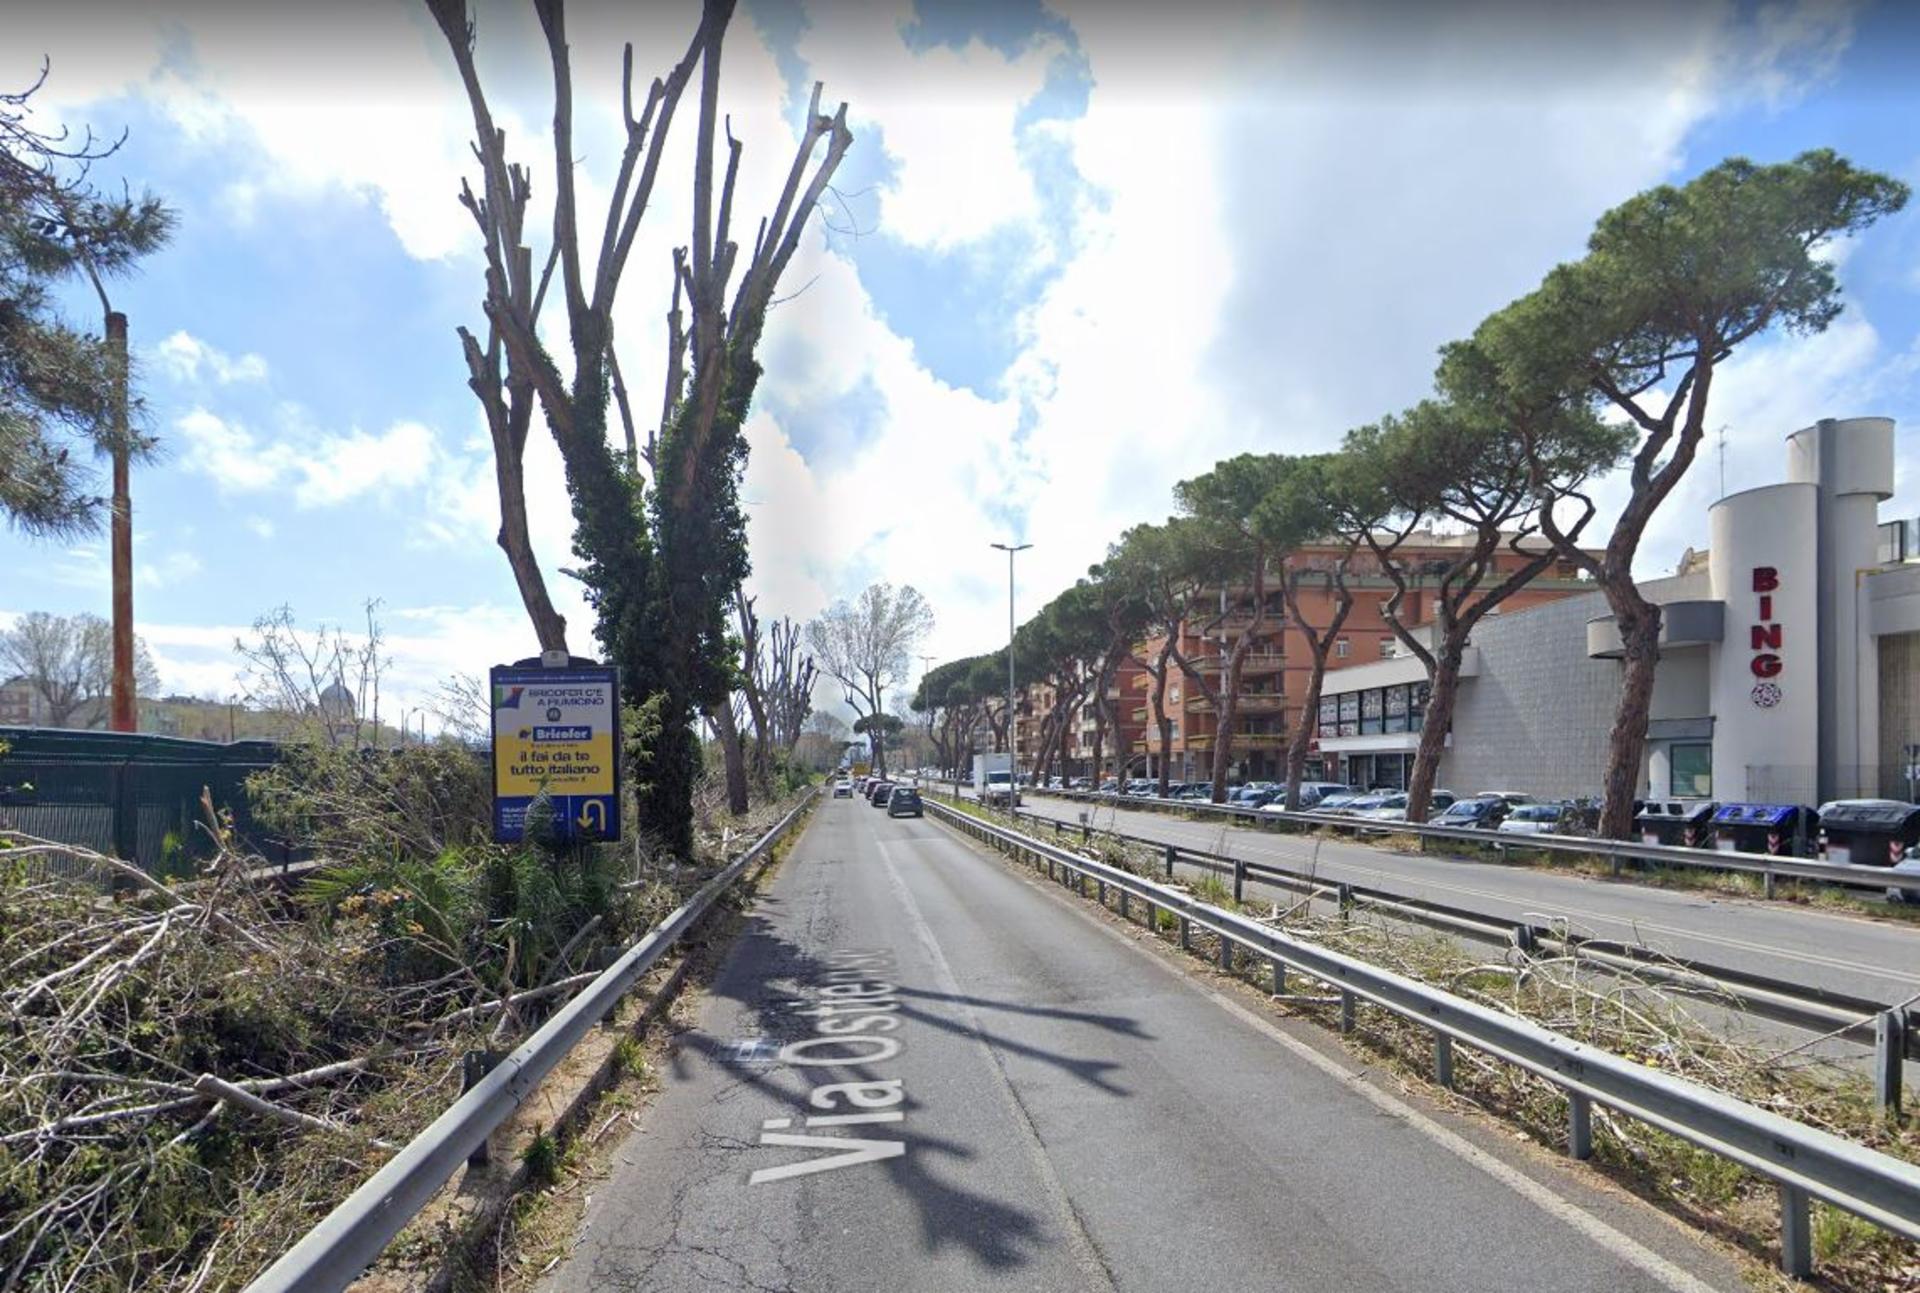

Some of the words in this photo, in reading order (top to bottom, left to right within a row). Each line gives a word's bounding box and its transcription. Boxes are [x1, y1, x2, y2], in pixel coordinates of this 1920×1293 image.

[536, 728, 588, 739] Bricofer
[520, 751, 528, 762] il
[531, 751, 549, 762] fai
[552, 751, 571, 762] da
[575, 751, 590, 761] te
[510, 765, 545, 775] tutto
[549, 764, 600, 774] italiano
